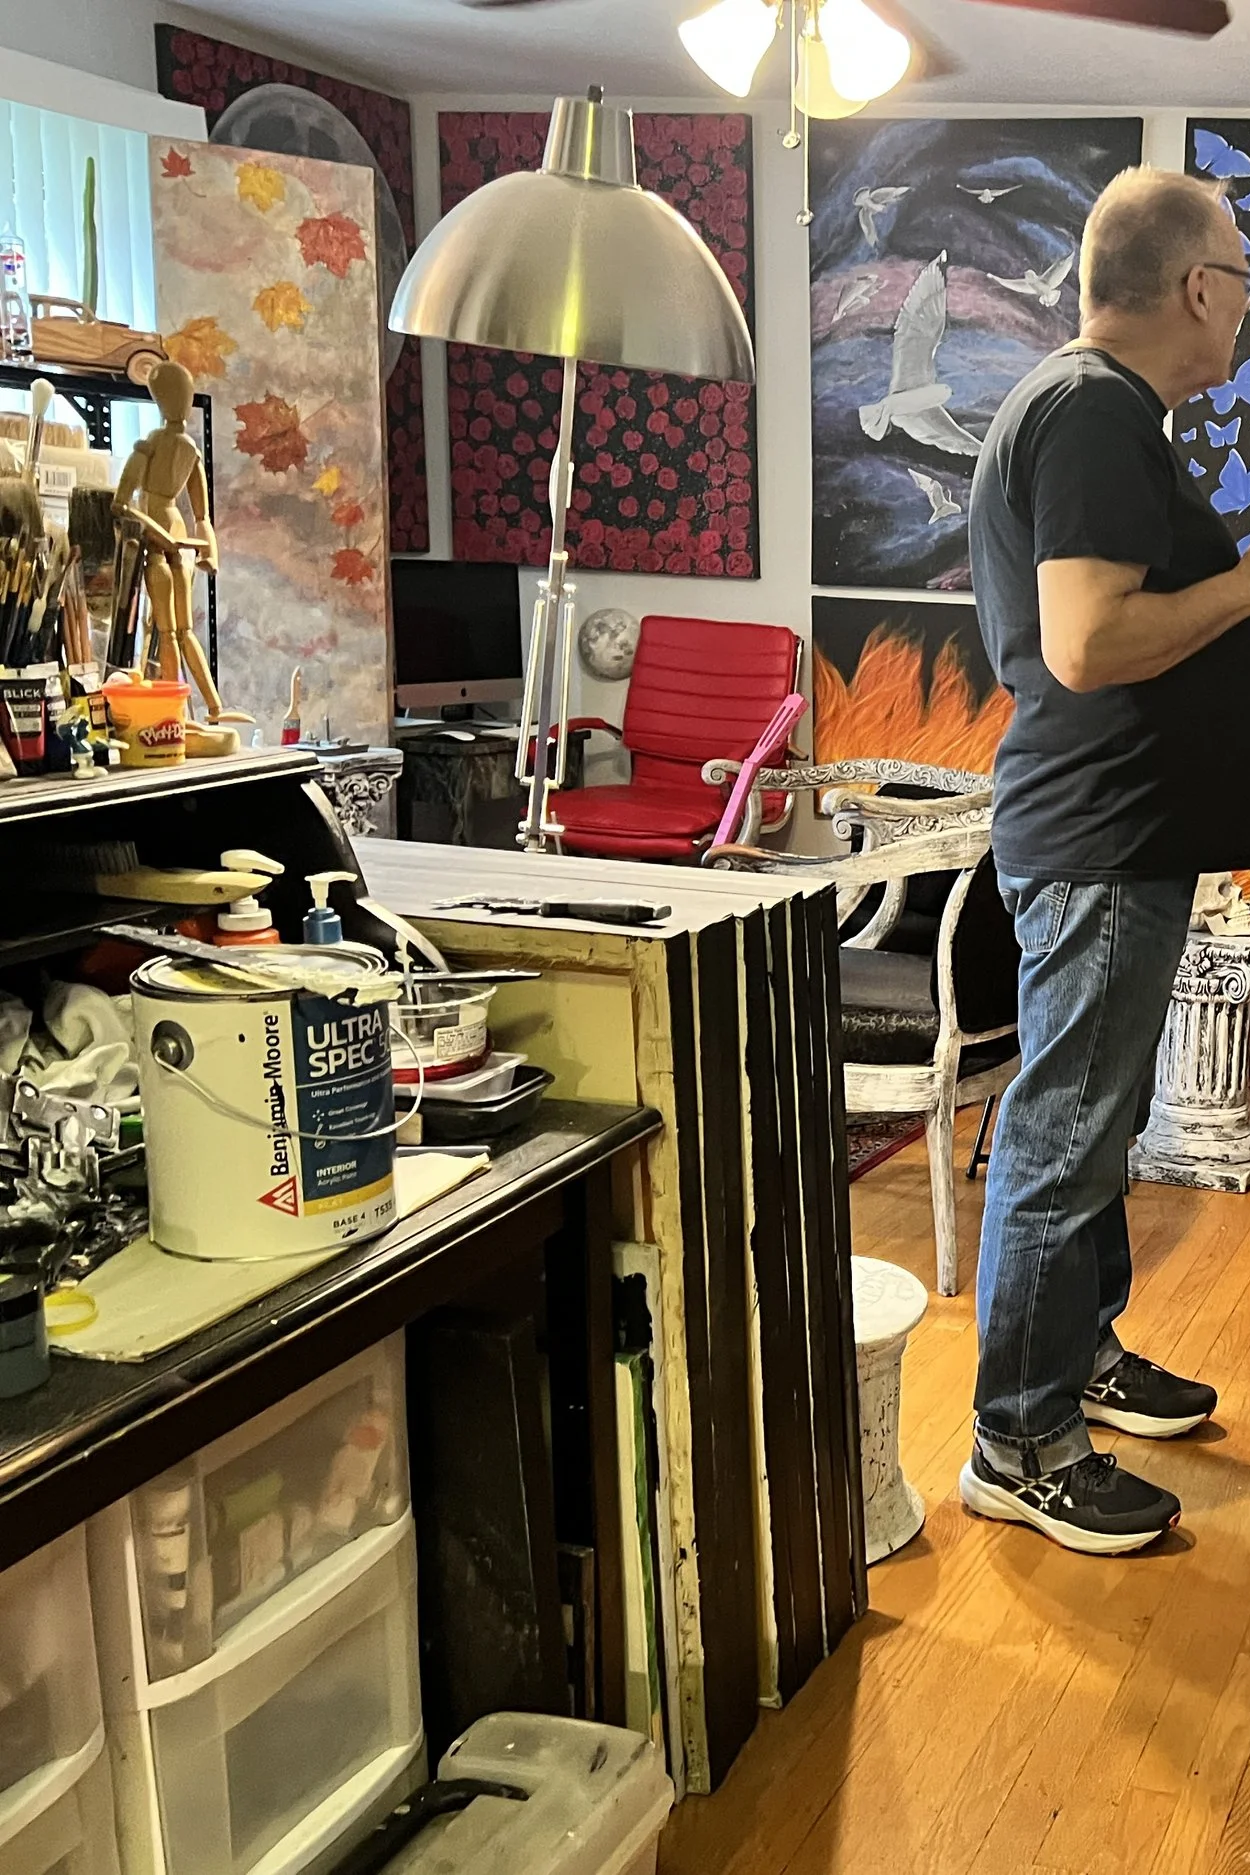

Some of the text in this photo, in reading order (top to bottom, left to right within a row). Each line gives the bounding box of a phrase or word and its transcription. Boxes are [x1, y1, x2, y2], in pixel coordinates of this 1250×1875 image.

[3, 688, 41, 699] BLICK
[306, 1008, 383, 1050] ULTRA
[262, 1014, 282, 1080] Moore
[308, 1039, 375, 1078] SPEC
[310, 1088, 331, 1098] Ultra
[316, 1160, 357, 1177] INTERIOR
[333, 1214, 358, 1228] BASE
[360, 1211, 366, 1220] 4
